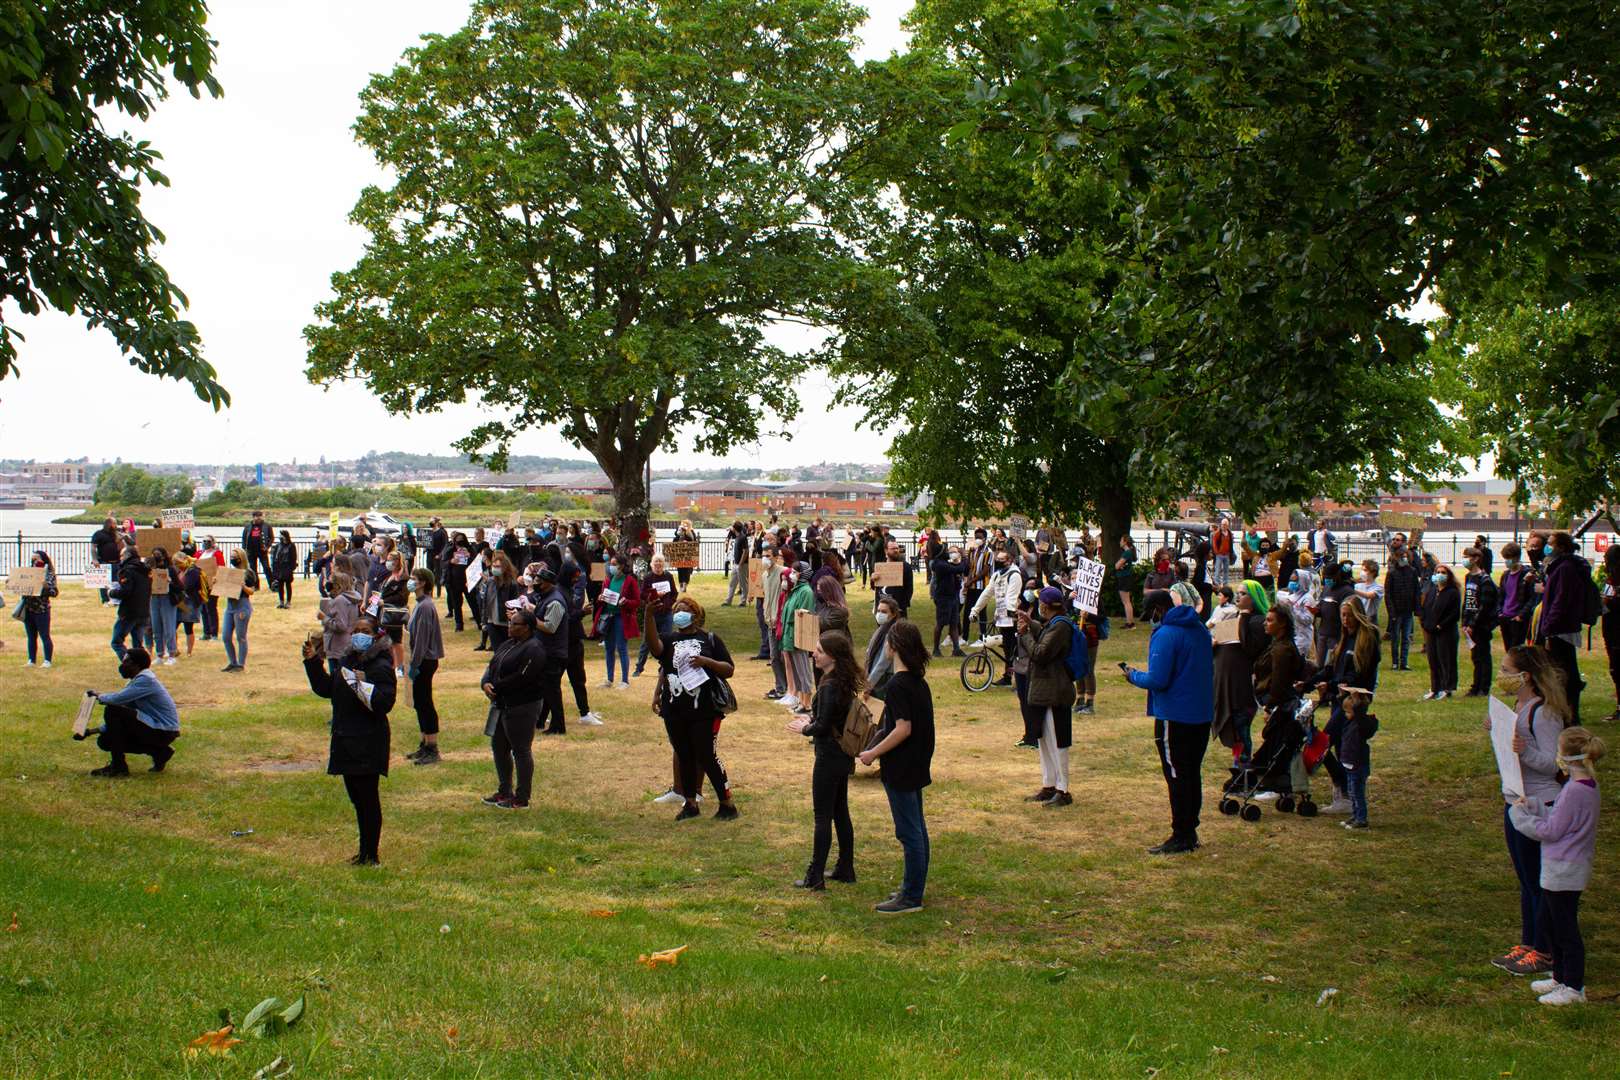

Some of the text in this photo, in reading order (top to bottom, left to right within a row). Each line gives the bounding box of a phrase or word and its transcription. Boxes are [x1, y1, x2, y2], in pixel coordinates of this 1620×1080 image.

[1079, 559, 1105, 578] BLACK
[1078, 573, 1100, 588] LIVES
[1075, 584, 1099, 608] MATTER
